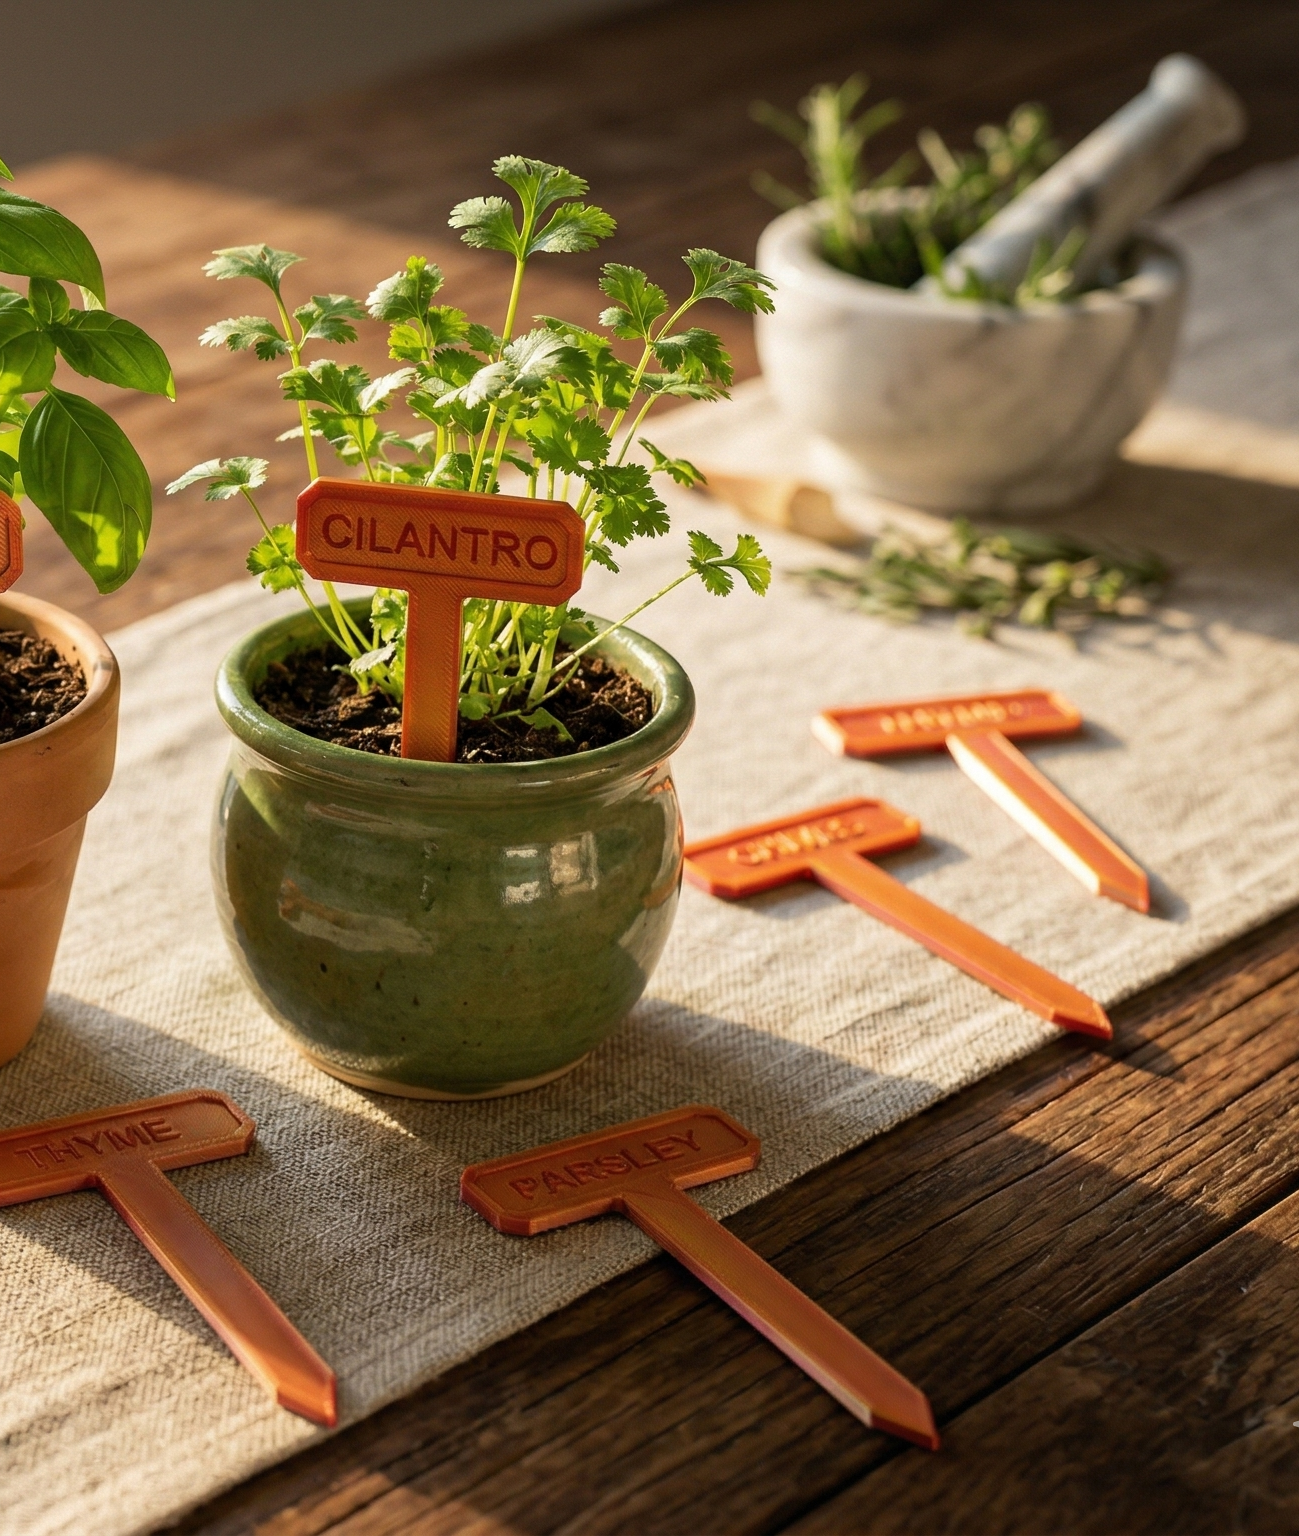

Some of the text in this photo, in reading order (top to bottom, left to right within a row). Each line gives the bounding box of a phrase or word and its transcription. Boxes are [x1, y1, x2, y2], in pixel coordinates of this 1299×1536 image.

[321, 513, 558, 570] CILANTRO
[14, 1117, 183, 1170] THYME
[508, 1129, 701, 1200] PARSLEY
